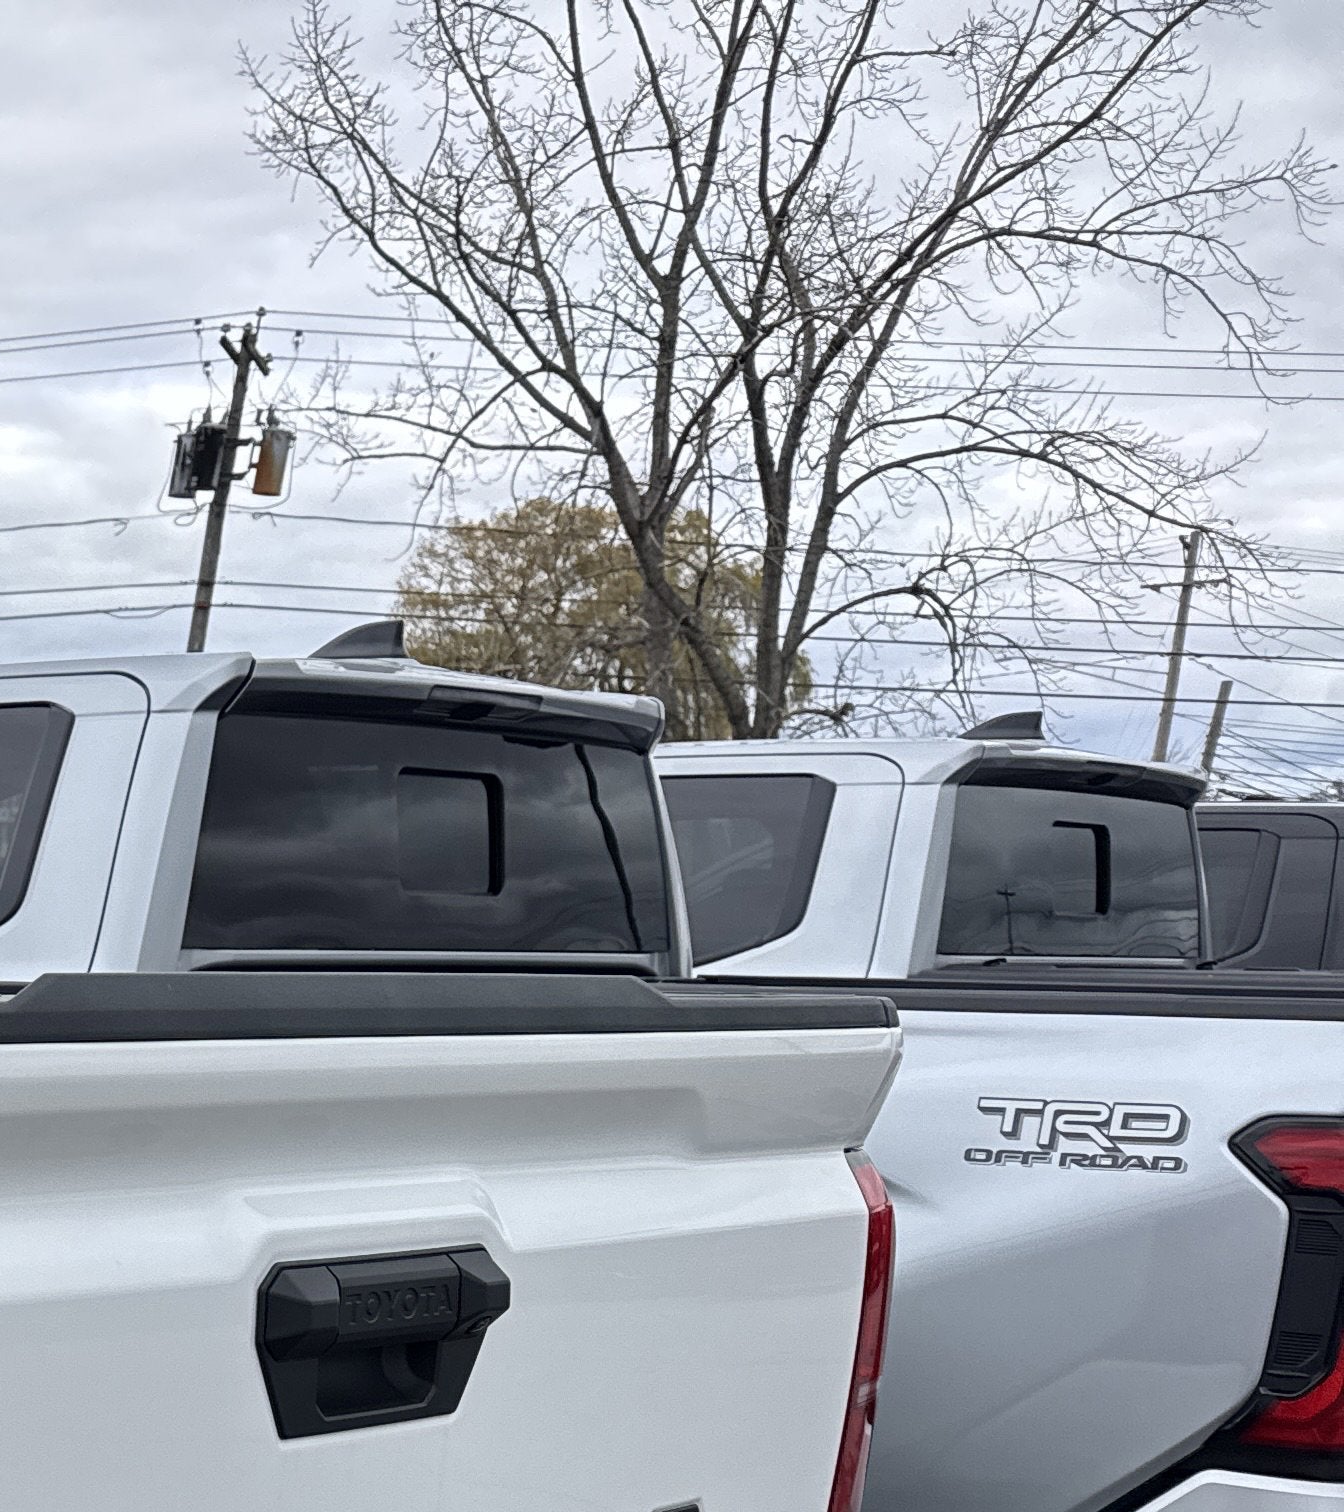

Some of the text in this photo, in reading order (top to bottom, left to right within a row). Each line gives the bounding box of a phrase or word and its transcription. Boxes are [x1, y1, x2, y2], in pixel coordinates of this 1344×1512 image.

[977, 1096, 1190, 1156] TRD
[964, 1148, 1188, 1174] OFF ROAD
[344, 1284, 454, 1326] TOYOTA
